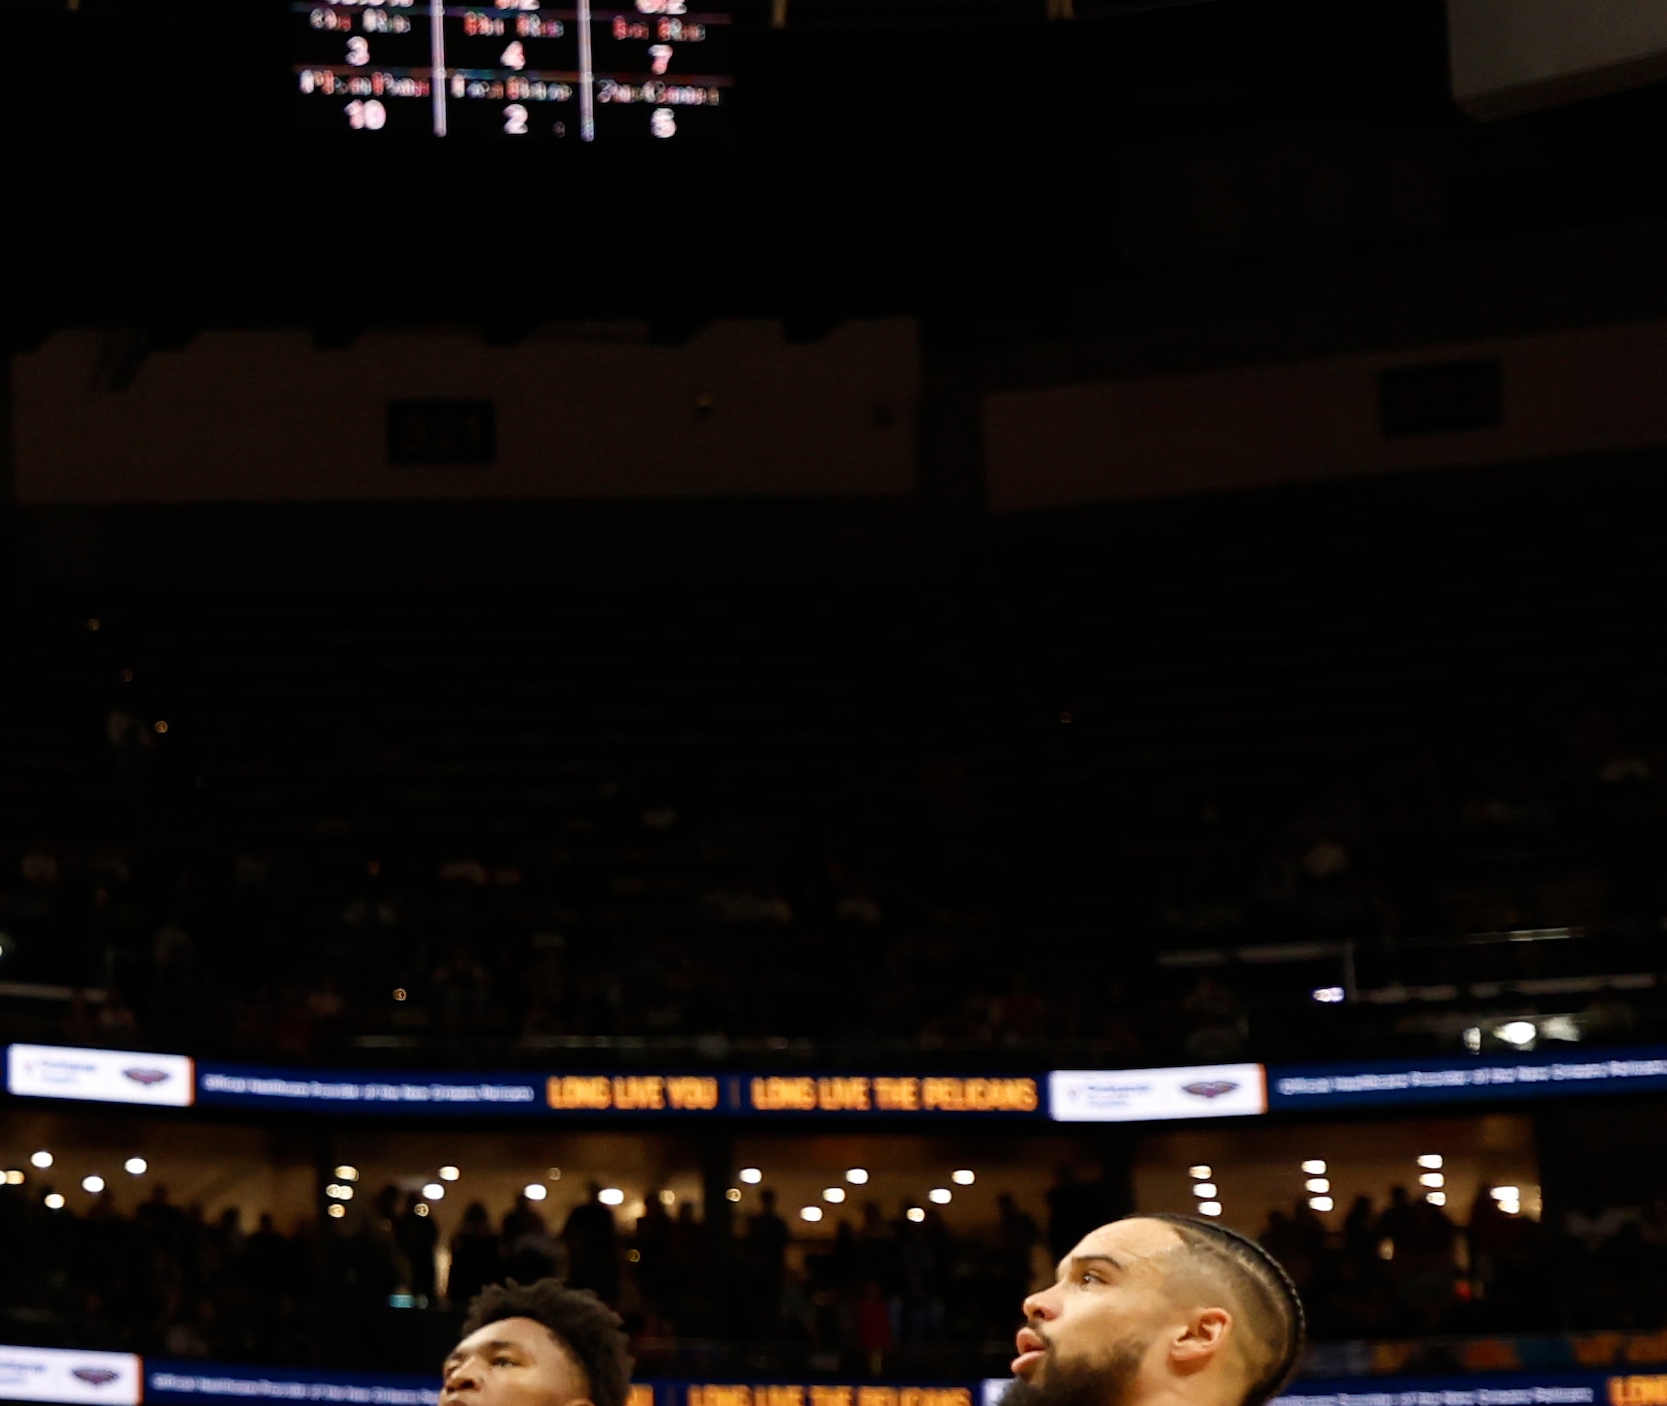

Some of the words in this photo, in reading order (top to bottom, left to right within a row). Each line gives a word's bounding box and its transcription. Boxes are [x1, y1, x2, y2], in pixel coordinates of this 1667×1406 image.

[547, 1076, 613, 1110] LONG
[613, 1076, 666, 1110] LIVE
[666, 1076, 718, 1110] YOU
[751, 1077, 817, 1111] LONG
[818, 1077, 871, 1111] LIVE
[873, 1077, 920, 1111] THE
[921, 1077, 1038, 1111] PELICANS
